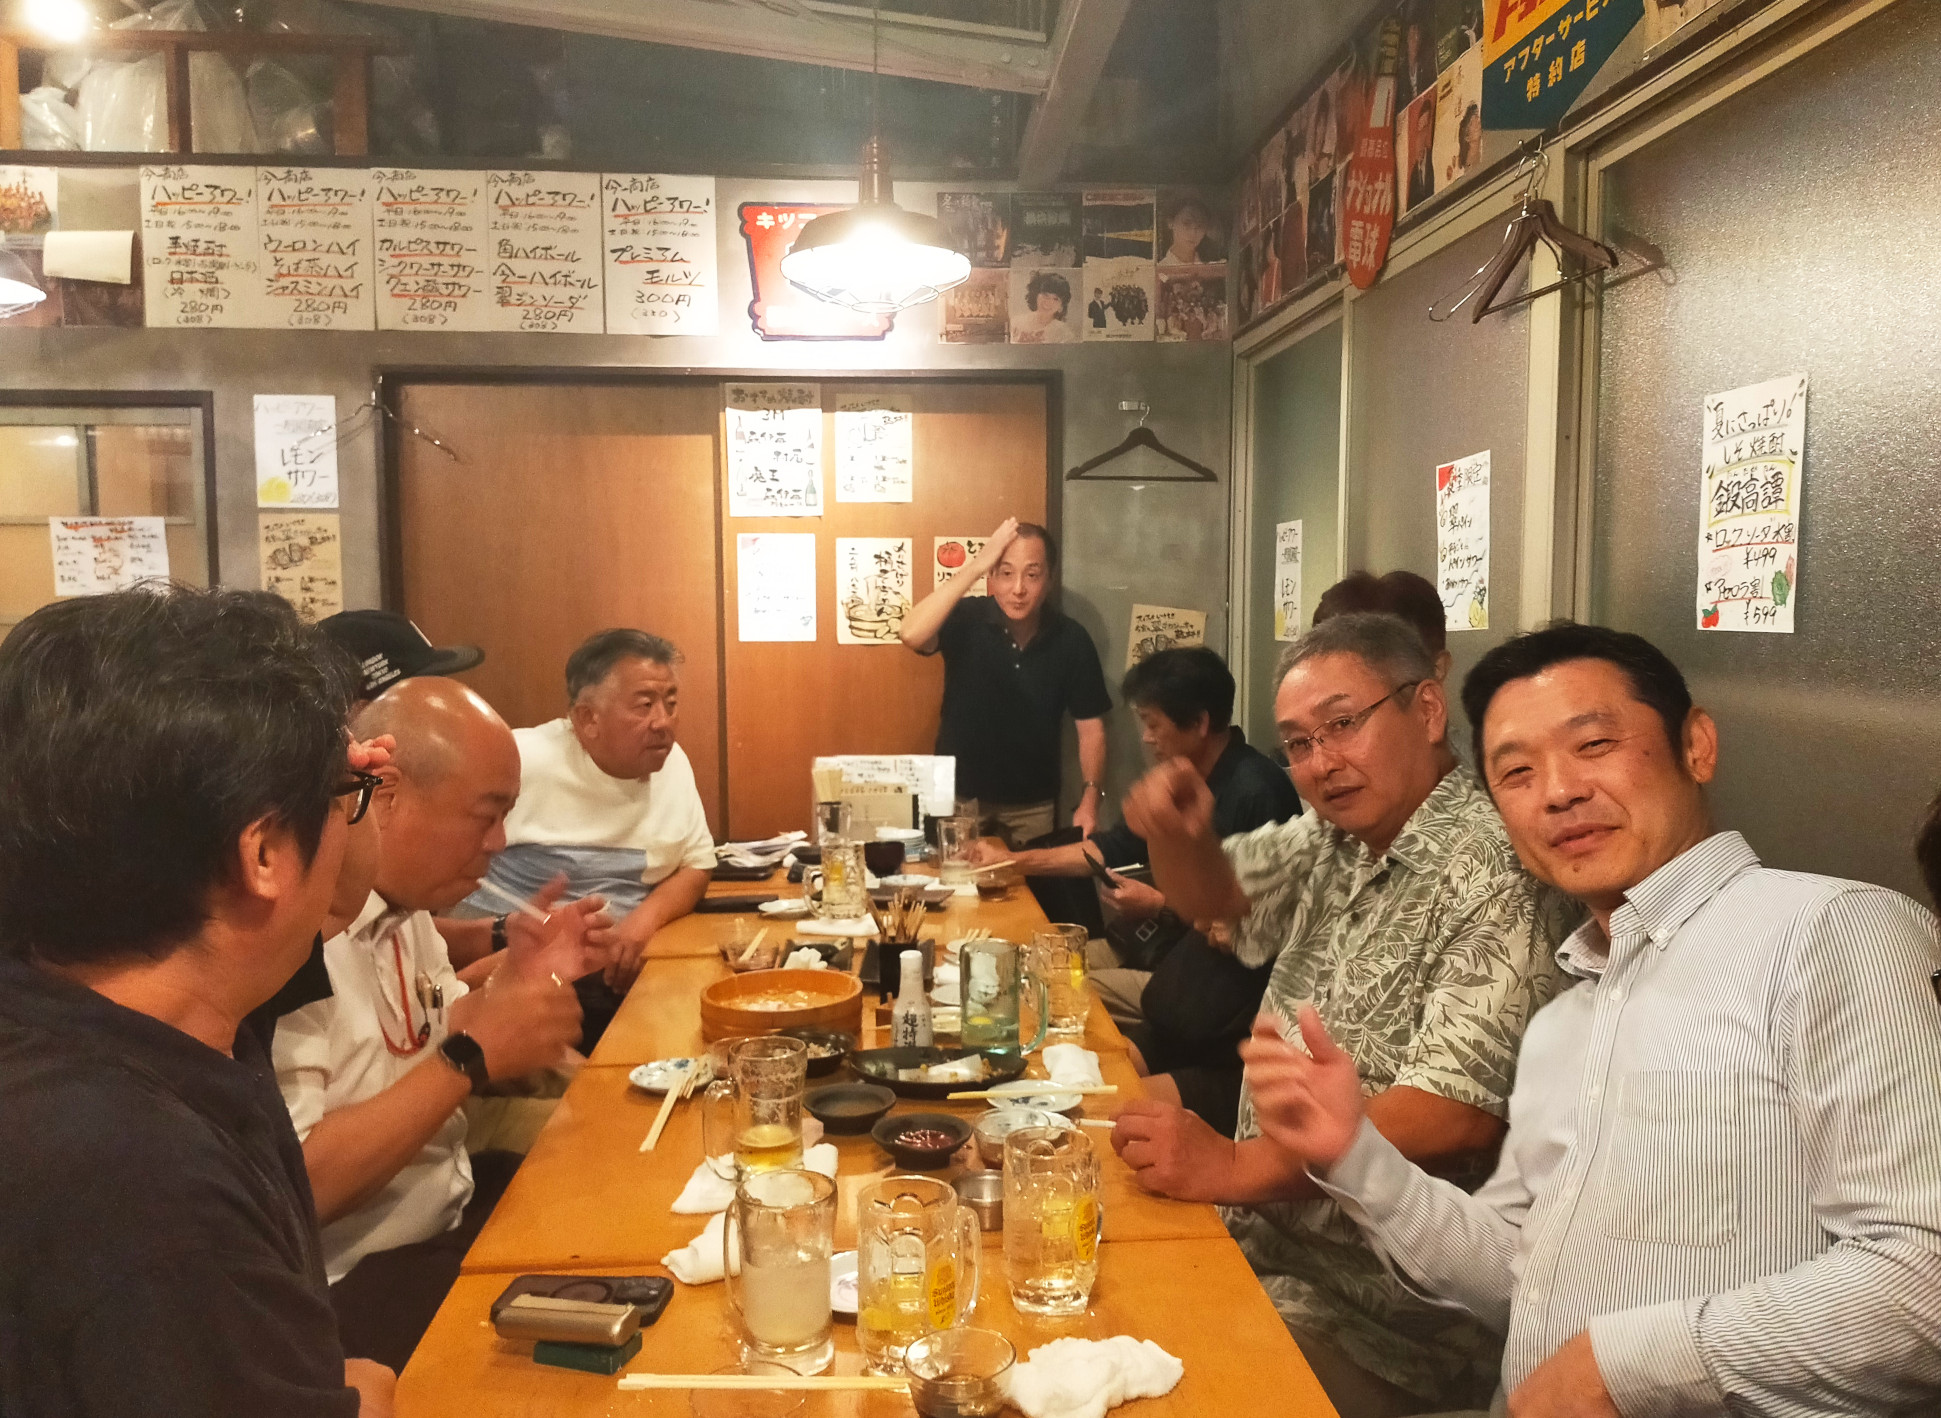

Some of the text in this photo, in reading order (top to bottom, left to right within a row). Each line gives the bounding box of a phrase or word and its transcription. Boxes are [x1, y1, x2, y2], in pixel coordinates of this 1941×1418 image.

[1504, 0, 1608, 83] アフターサービ
[1526, 39, 1586, 102] 特約店
[1346, 169, 1393, 215] ナショナル
[264, 234, 360, 256] ウーロンハイ
[379, 238, 477, 254] カルピスサワー
[498, 239, 582, 262] 角ハイボール
[610, 245, 686, 263] プレミアム
[1349, 220, 1380, 270] 電球
[171, 271, 219, 285] 日本酒
[645, 269, 701, 285] モルツ
[180, 300, 223, 314] 280円
[293, 299, 347, 314] 280円
[407, 297, 458, 312] 280円
[635, 290, 691, 307] 300円
[522, 308, 574, 322] 280円
[281, 445, 323, 466] レモン
[1724, 433, 1785, 464] しそ焼酎
[287, 468, 329, 487] サワー
[1710, 471, 1784, 517] 鍛高譚
[1743, 547, 1777, 569] ¥499
[1744, 599, 1777, 626] ¥599
